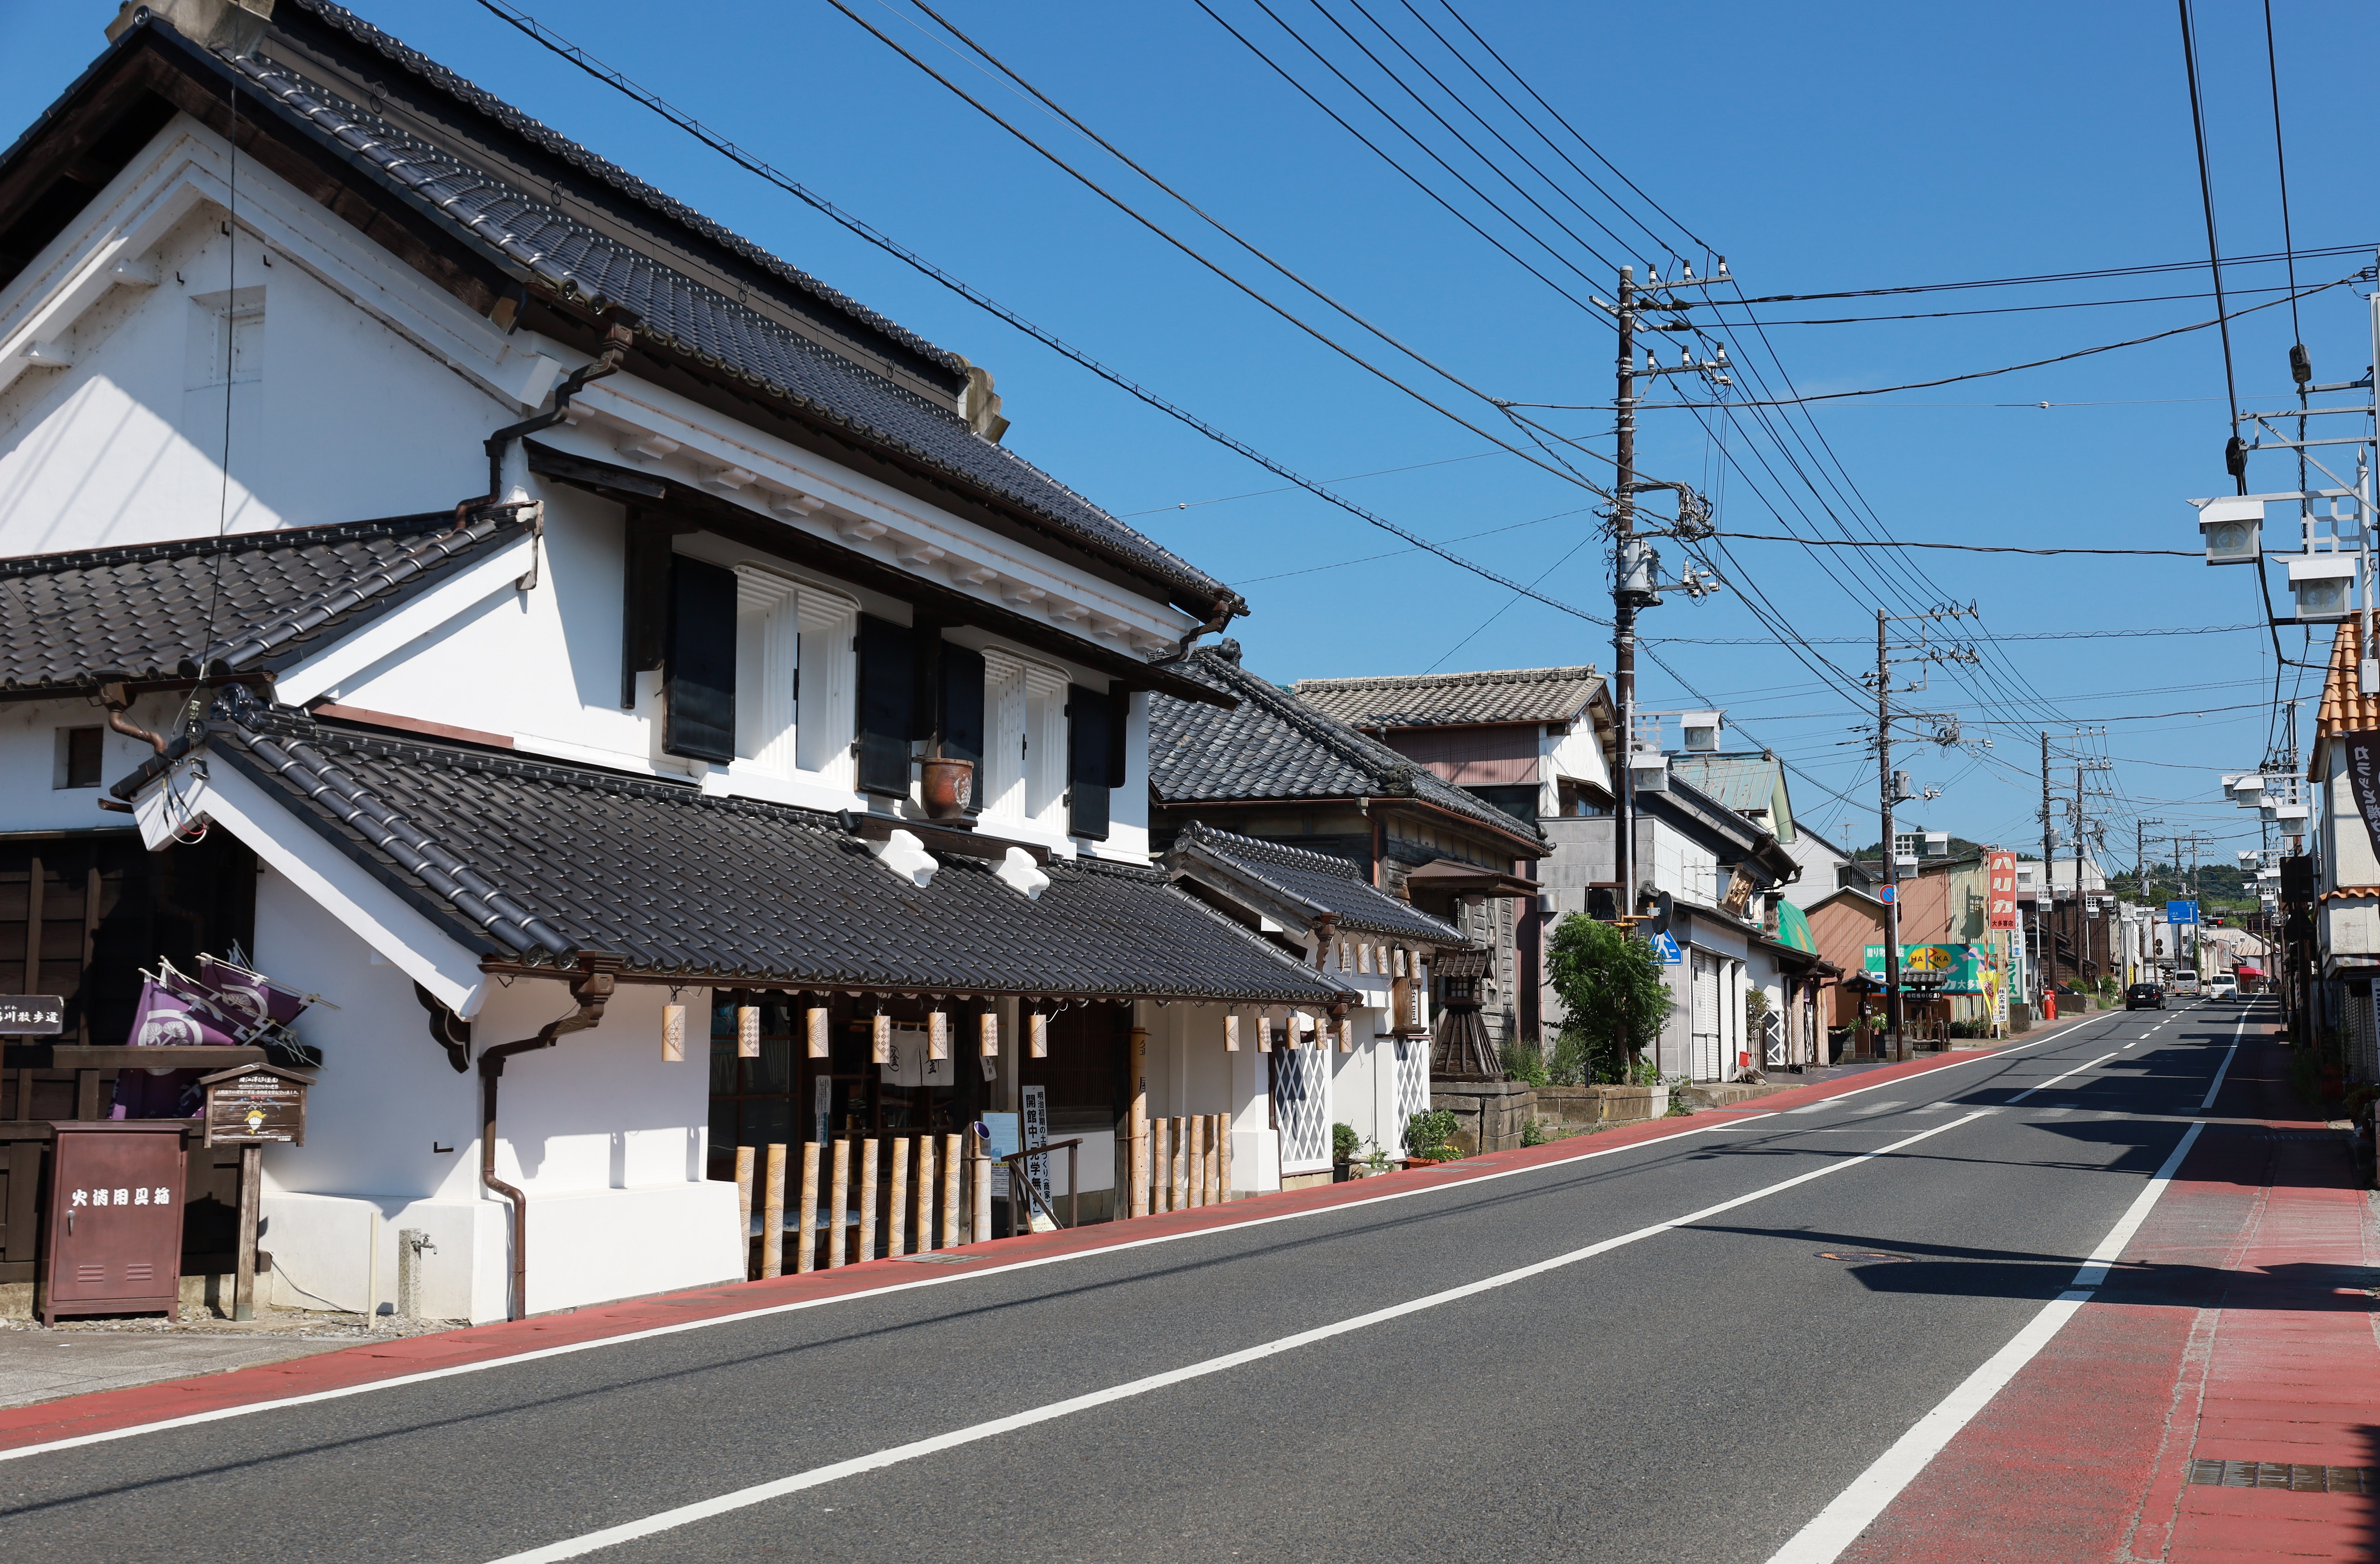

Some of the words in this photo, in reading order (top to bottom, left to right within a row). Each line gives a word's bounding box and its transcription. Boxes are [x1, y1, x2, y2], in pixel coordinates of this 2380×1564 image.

[1991, 856, 2014, 913] ハリカ
[72, 1187, 170, 1207] 火消用具箱
